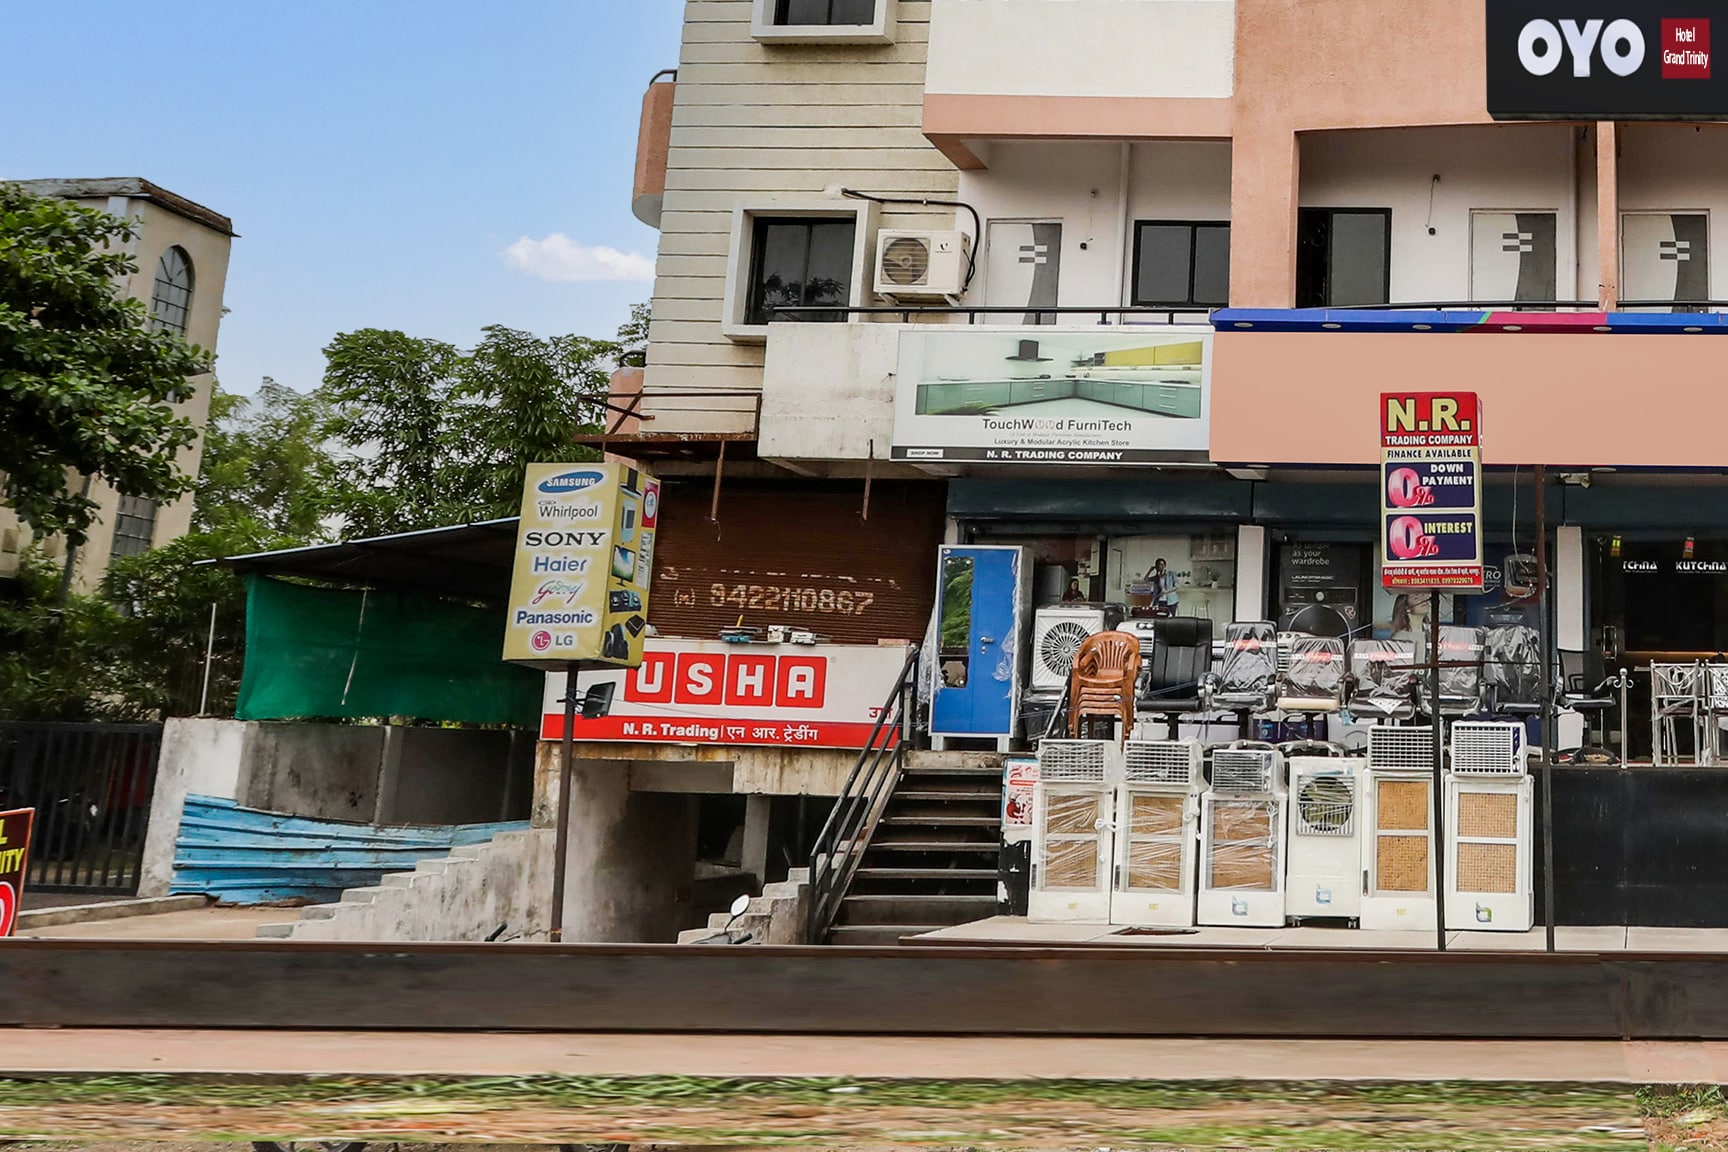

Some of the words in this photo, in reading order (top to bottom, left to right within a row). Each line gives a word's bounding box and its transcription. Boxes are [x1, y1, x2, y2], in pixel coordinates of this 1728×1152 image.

[1675, 27, 1695, 42] Hotel
[1517, 18, 1645, 78] OYO
[1664, 50, 1685, 65] Grand
[1685, 50, 1708, 69] Trinity
[1387, 397, 1471, 432] N.R.
[1068, 419, 1132, 431] FurniTech
[994, 438, 1018, 446] Luxury
[1385, 435, 1426, 445] TRADING
[1428, 435, 1473, 445] COMPANY
[986, 450, 998, 458] N.
[1015, 451, 1065, 459] TRADING
[1067, 451, 1123, 460] COMPANY
[1387, 450, 1421, 458] FINANCE
[1425, 449, 1471, 457] AVAILABLE
[1430, 464, 1464, 473] DOWN
[546, 478, 596, 487] SAMSUNG
[1388, 467, 1435, 508] 0%
[1422, 476, 1473, 485] PAYMENT
[539, 505, 598, 520] Whirlpool
[1424, 522, 1473, 534] INTEREST
[525, 532, 606, 546] SONY
[1389, 516, 1439, 559] 0%
[534, 556, 587, 571] Haier
[516, 610, 593, 624] Panasonic
[555, 635, 573, 646] LG
[636, 660, 816, 699] USHA
[623, 723, 639, 736] N.
[642, 723, 658, 736] R.
[660, 724, 718, 739] Trading
[727, 726, 745, 739] एन
[752, 727, 780, 739] आर.
[0, 848, 25, 874] ITY
